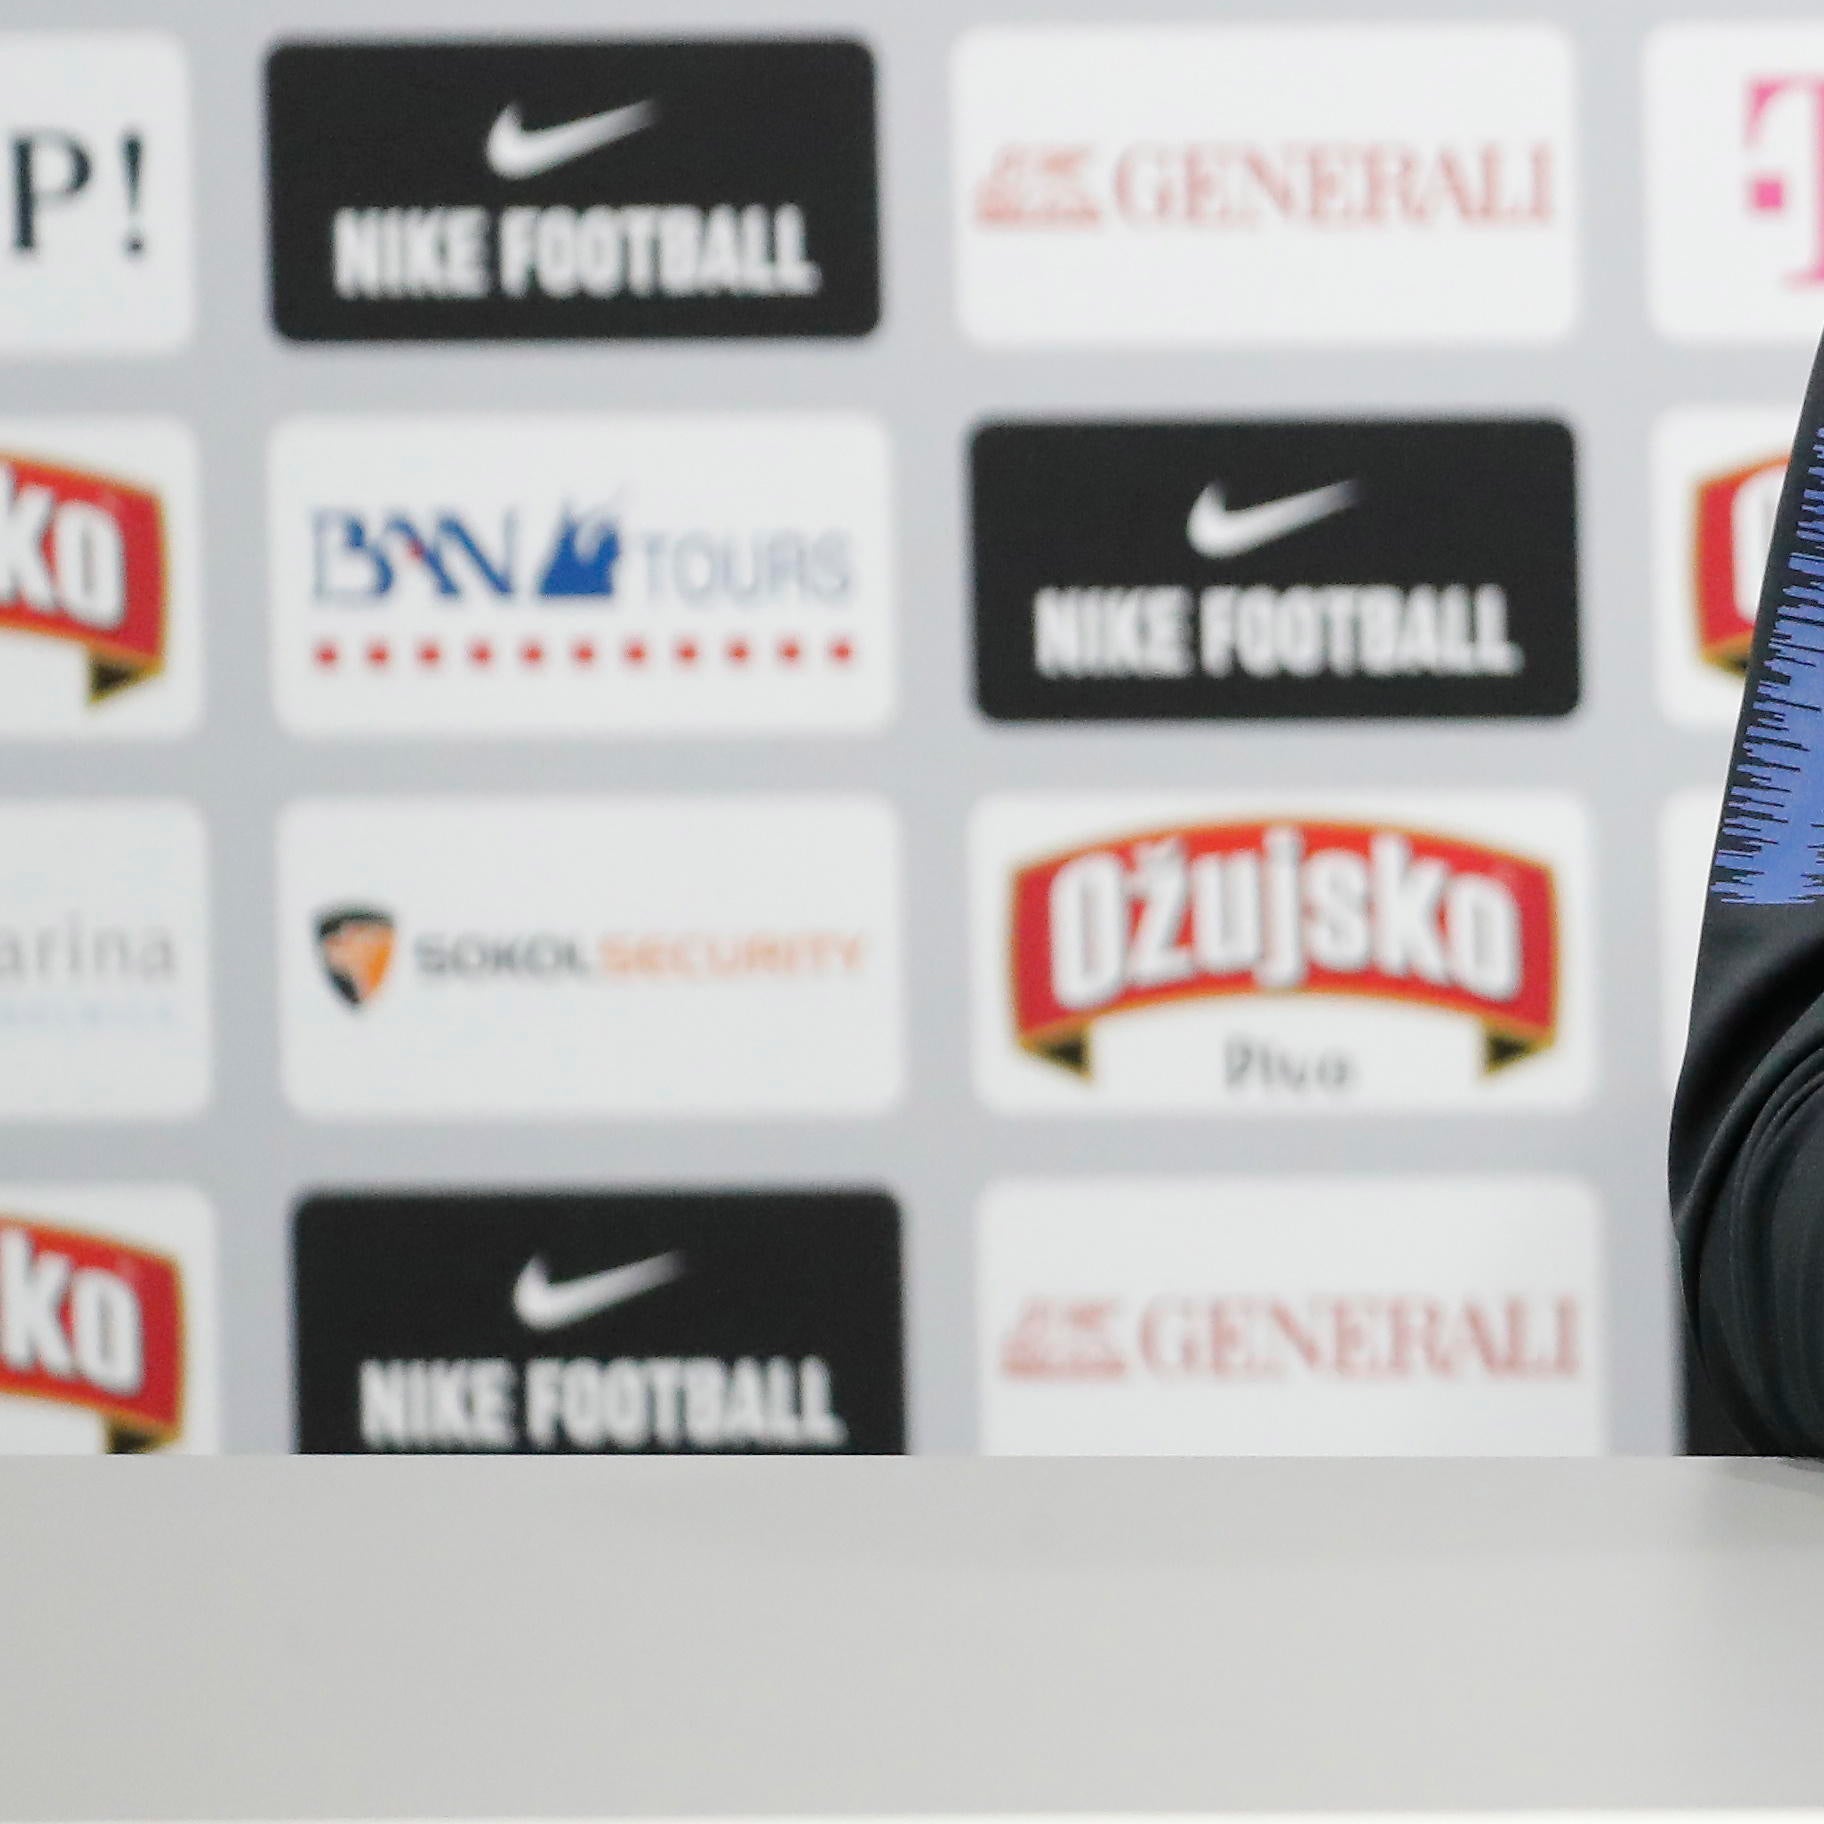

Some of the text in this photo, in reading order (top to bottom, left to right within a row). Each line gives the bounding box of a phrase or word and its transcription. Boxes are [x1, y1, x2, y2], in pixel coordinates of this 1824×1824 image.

[1113, 141, 1554, 231] GENERALI
[330, 202, 823, 301] NIKE FOOTBALL
[1031, 582, 1525, 681] NIKE FOOTBALL
[1050, 828, 1523, 1010] Ožujsko
[1138, 1291, 1582, 1381] GENERALI
[357, 1355, 848, 1451] NIKE FOOTBALL
